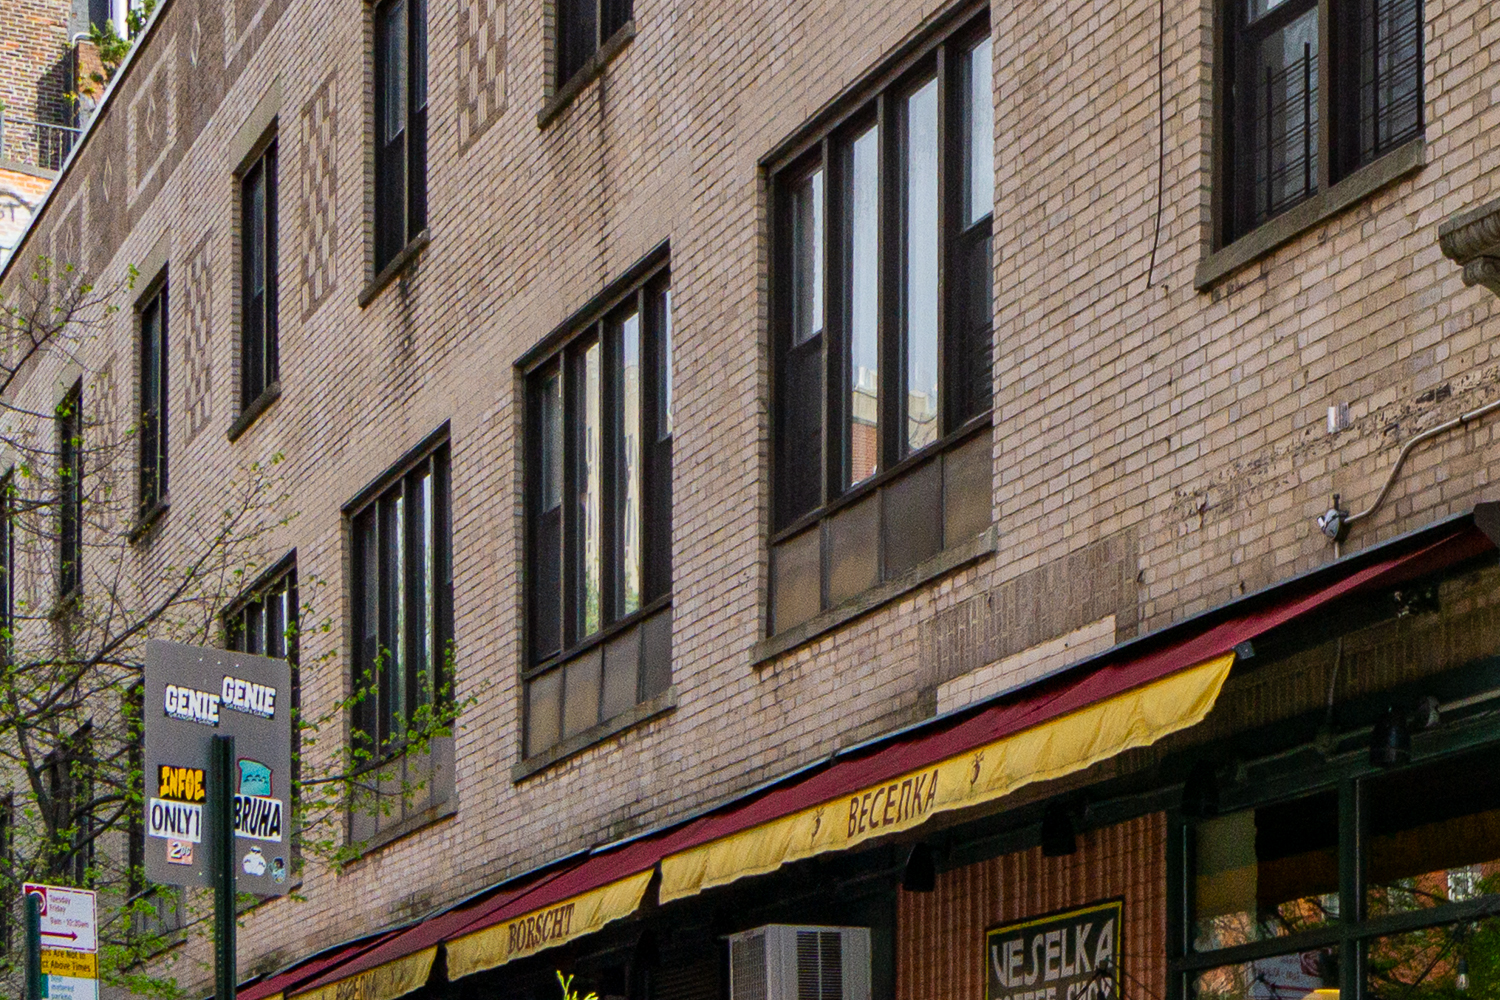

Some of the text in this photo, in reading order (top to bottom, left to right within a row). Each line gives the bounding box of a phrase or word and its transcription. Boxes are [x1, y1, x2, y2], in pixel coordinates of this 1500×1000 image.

[165, 684, 220, 723] GENIE
[222, 675, 277, 717] GENIE
[507, 902, 576, 955] BORSCHT
[991, 917, 1114, 988] VESELKA
